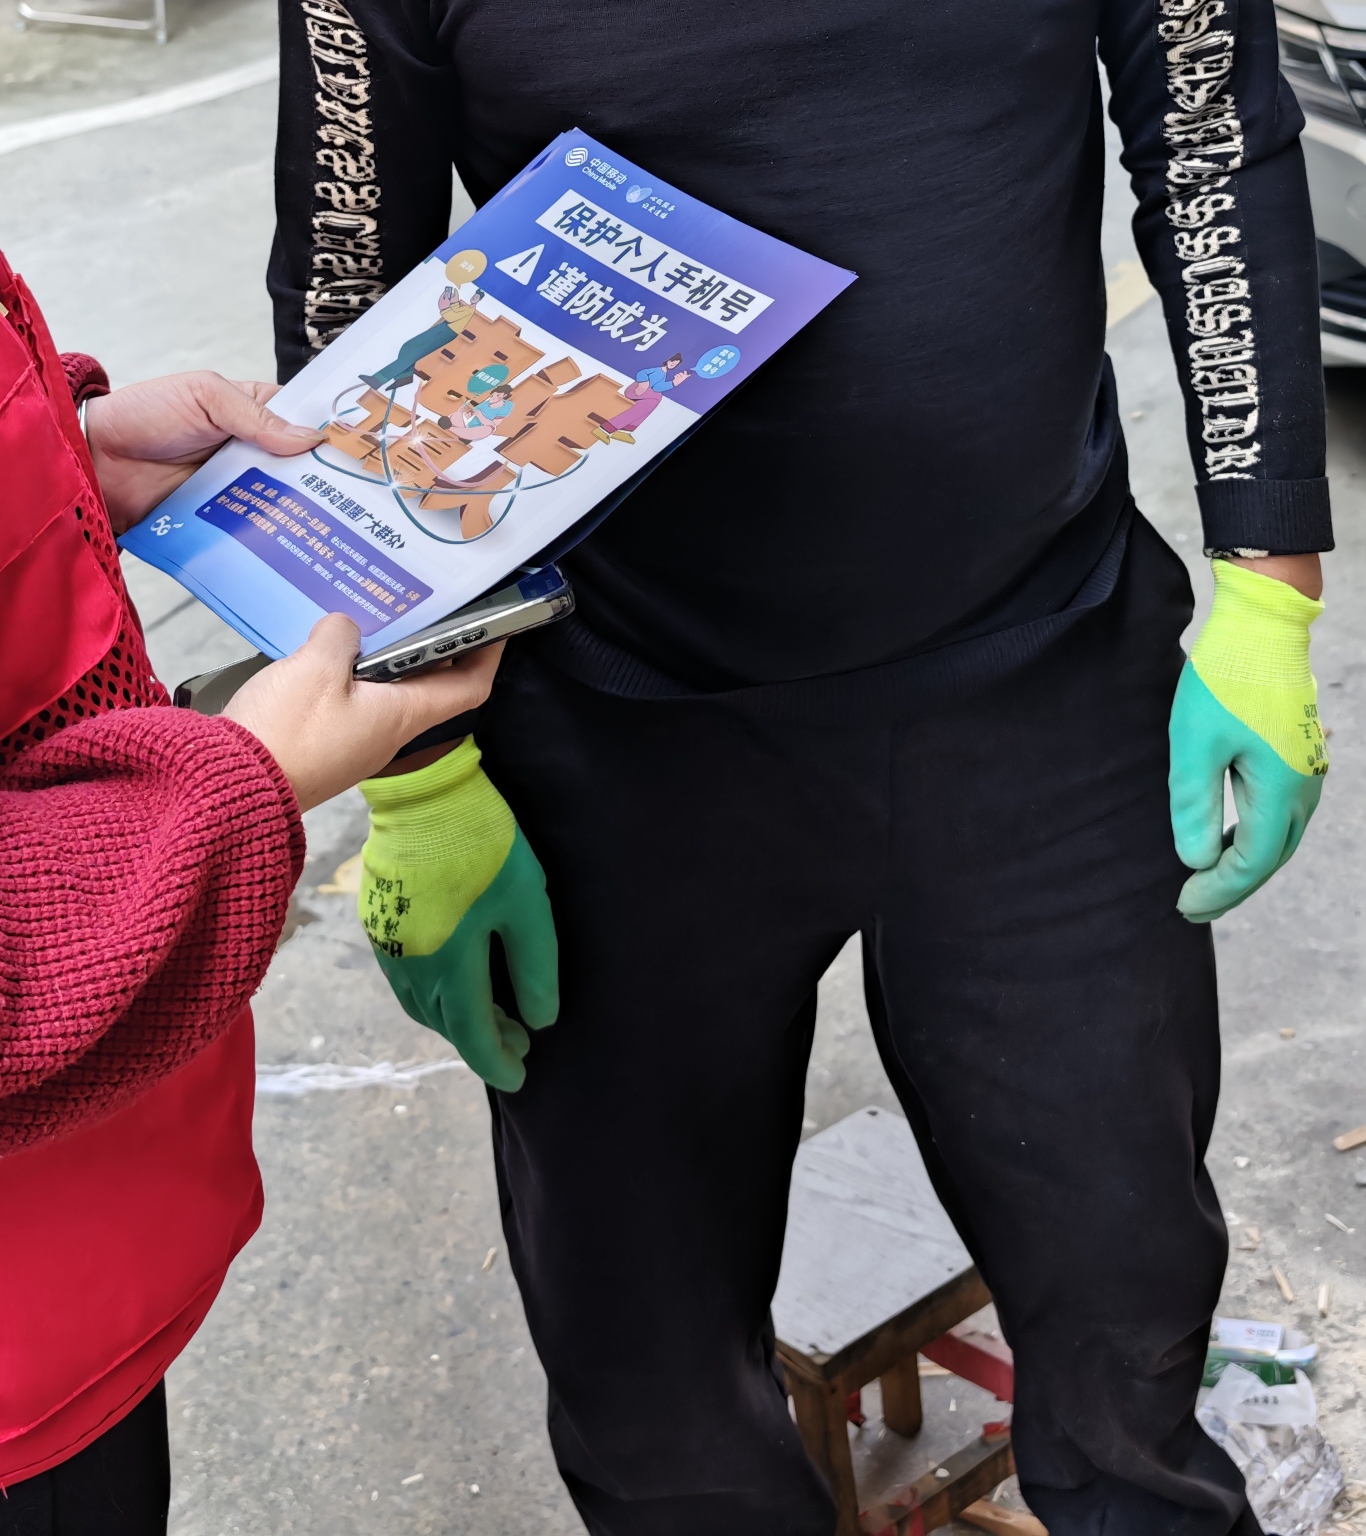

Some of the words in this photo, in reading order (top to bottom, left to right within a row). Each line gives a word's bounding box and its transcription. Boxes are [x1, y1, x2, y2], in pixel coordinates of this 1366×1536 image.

[581, 166, 598, 181] China
[596, 175, 617, 191] Mobile
[589, 158, 628, 185] 中国移动
[553, 201, 757, 322] 保护个人手机号
[536, 261, 669, 352] 谨防成为
[149, 514, 172, 537] 5G
